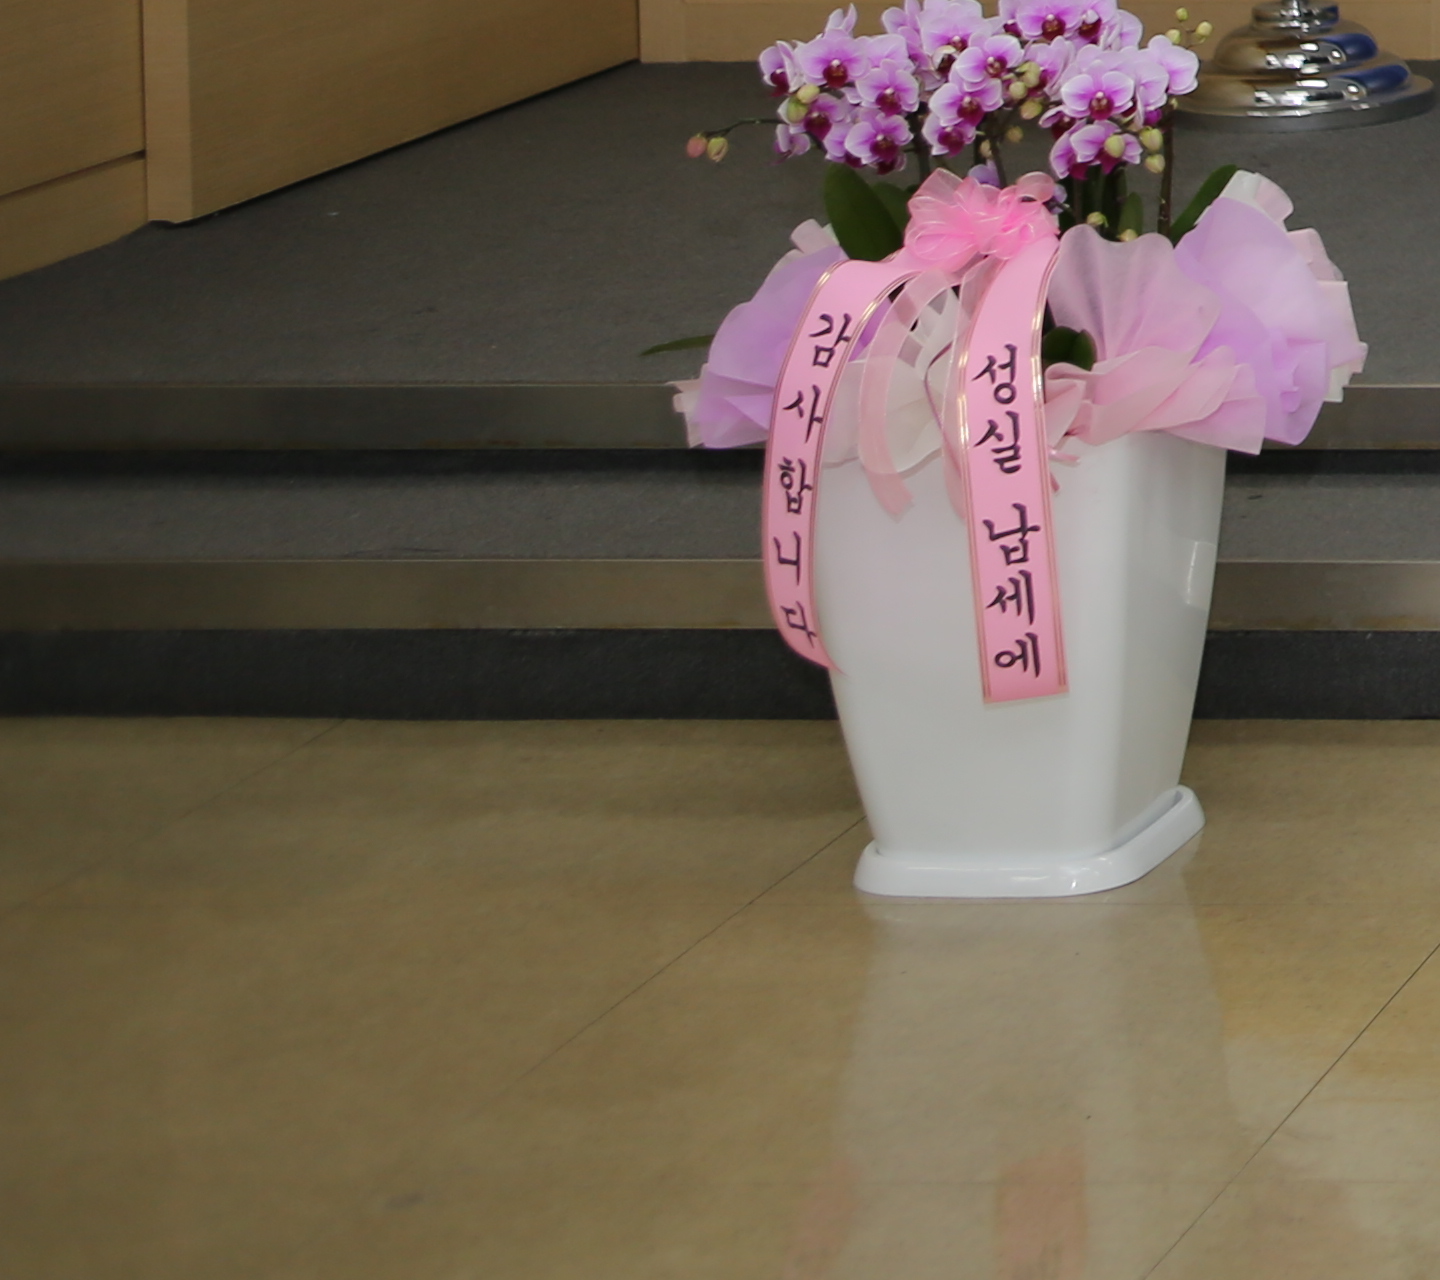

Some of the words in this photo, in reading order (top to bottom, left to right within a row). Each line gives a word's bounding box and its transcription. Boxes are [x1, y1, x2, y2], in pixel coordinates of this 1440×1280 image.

[773, 311, 852, 650] 감사합니다
[971, 343, 1024, 477] 성실
[982, 502, 1042, 680] 납세에
